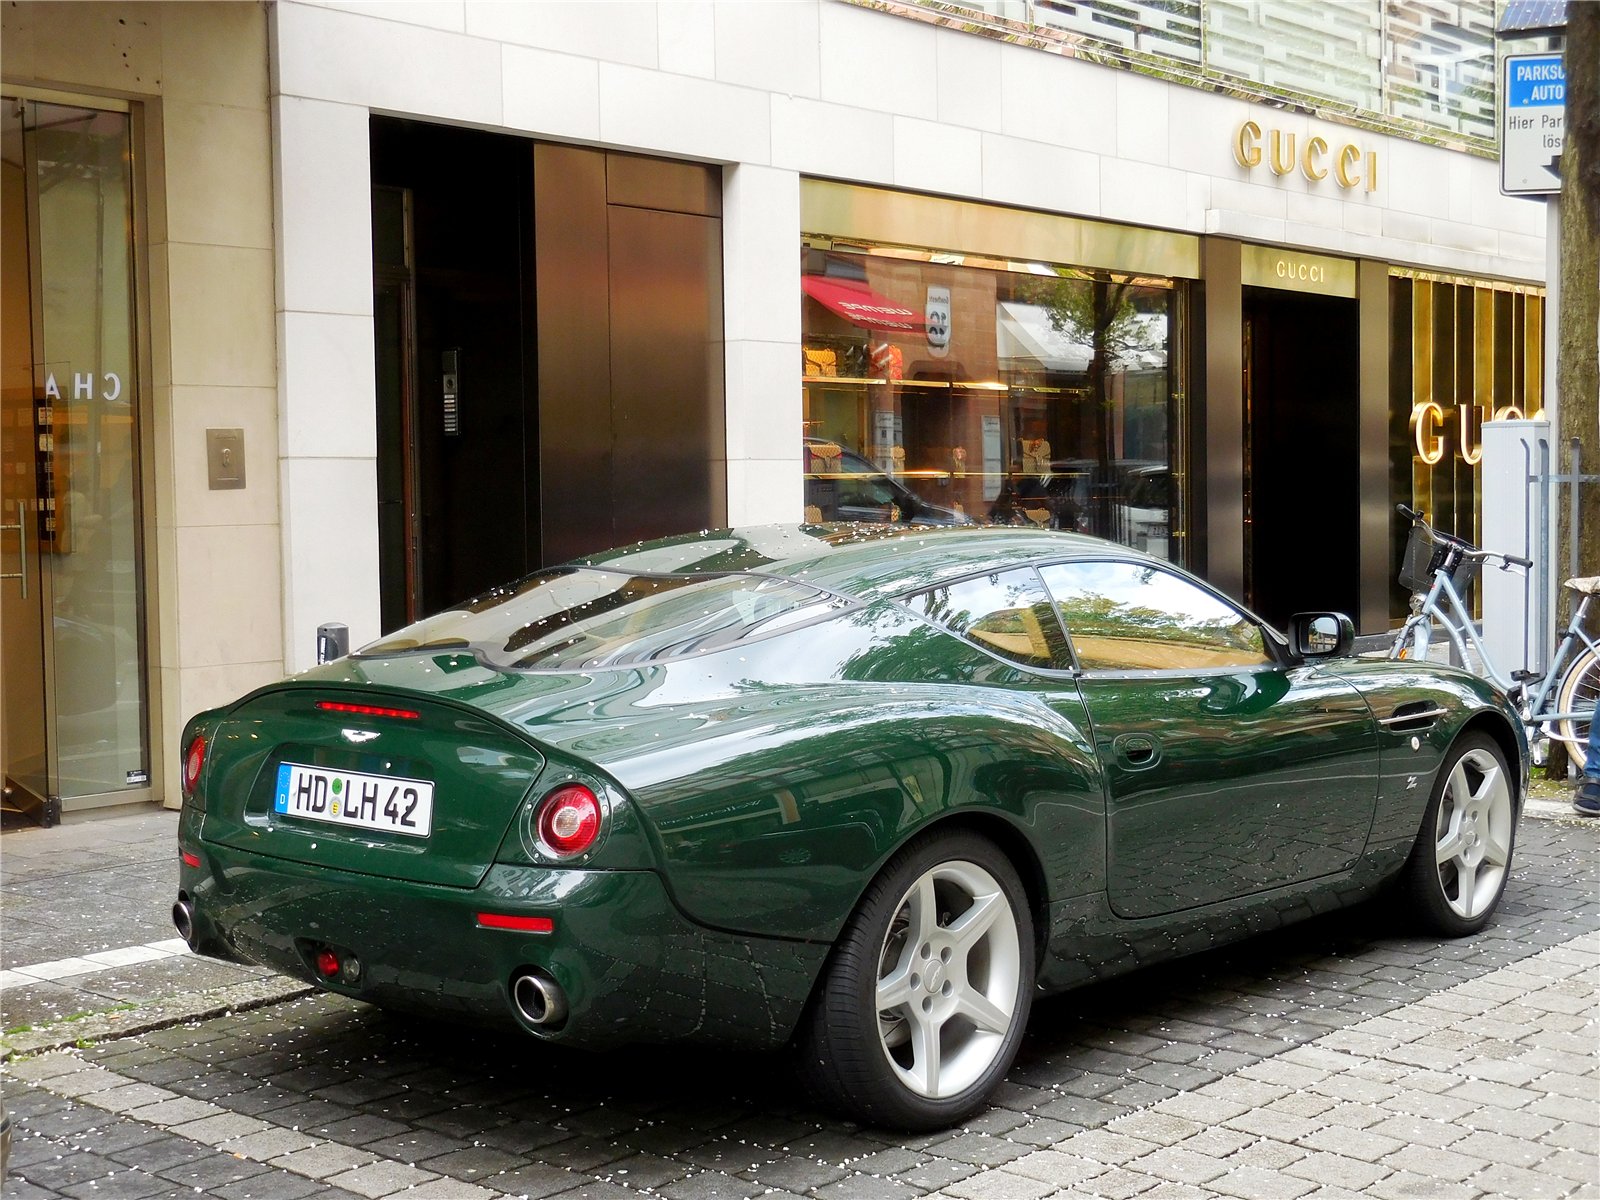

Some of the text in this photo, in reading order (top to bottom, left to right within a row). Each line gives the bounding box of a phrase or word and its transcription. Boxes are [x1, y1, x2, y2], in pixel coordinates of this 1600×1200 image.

[1531, 85, 1564, 100] AUTO
[1509, 114, 1566, 130] Hier Par
[1543, 134, 1563, 148] lös
[1233, 121, 1377, 193] GUCCI
[1276, 260, 1324, 283] GUCCI
[279, 793, 286, 805] D
[296, 773, 419, 828] HD LH 42
